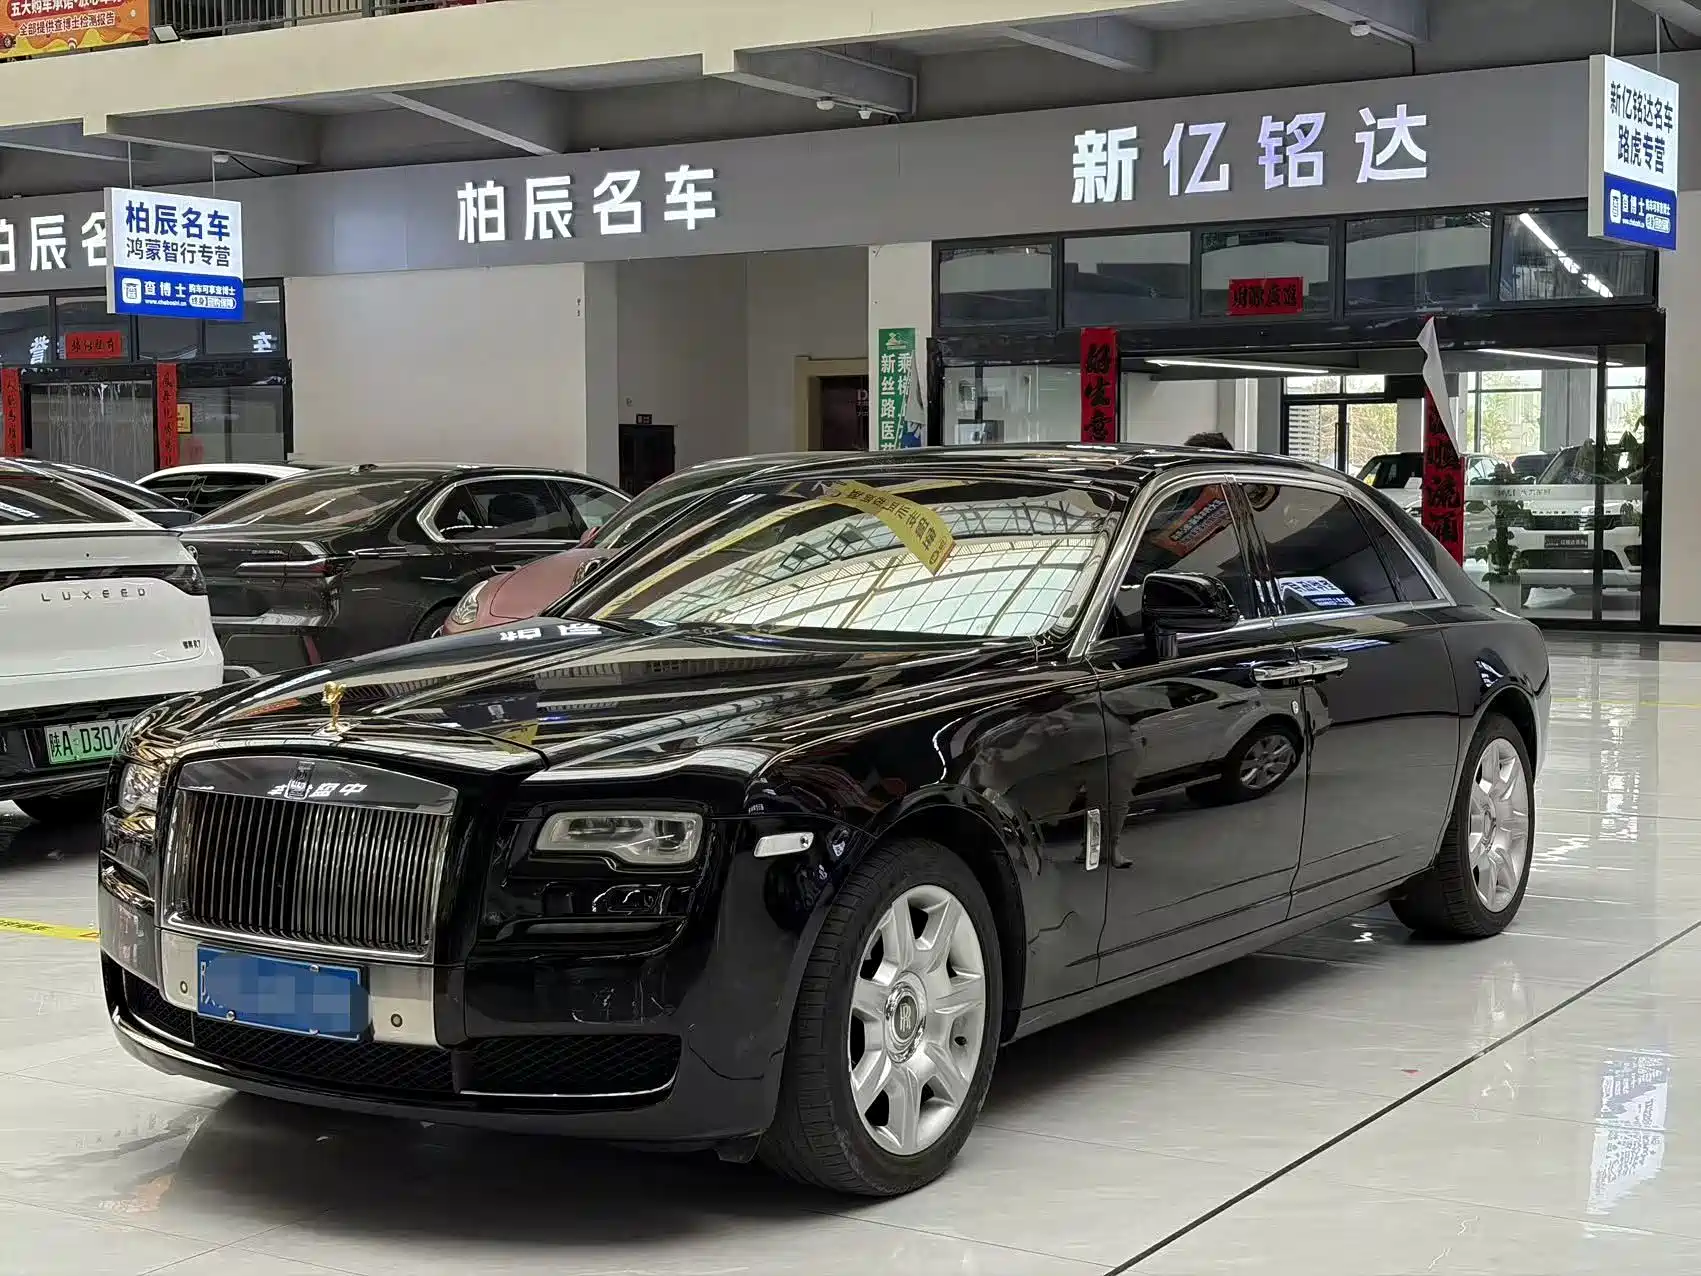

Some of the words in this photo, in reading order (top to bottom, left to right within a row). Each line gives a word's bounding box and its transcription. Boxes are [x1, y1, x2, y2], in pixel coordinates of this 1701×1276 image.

[19, 11, 116, 37] 全部提供查博士检测报告
[1609, 80, 1674, 134] 新亿铭达名车
[1071, 103, 1428, 204] 新亿铭达
[1617, 124, 1666, 175] 路虎专营
[125, 199, 231, 242] 柏辰名车
[456, 164, 717, 243] 柏辰名车
[125, 236, 231, 268] 鸿蒙智行专营
[143, 280, 187, 298] 查博士
[41, 587, 146, 602] LUXEED
